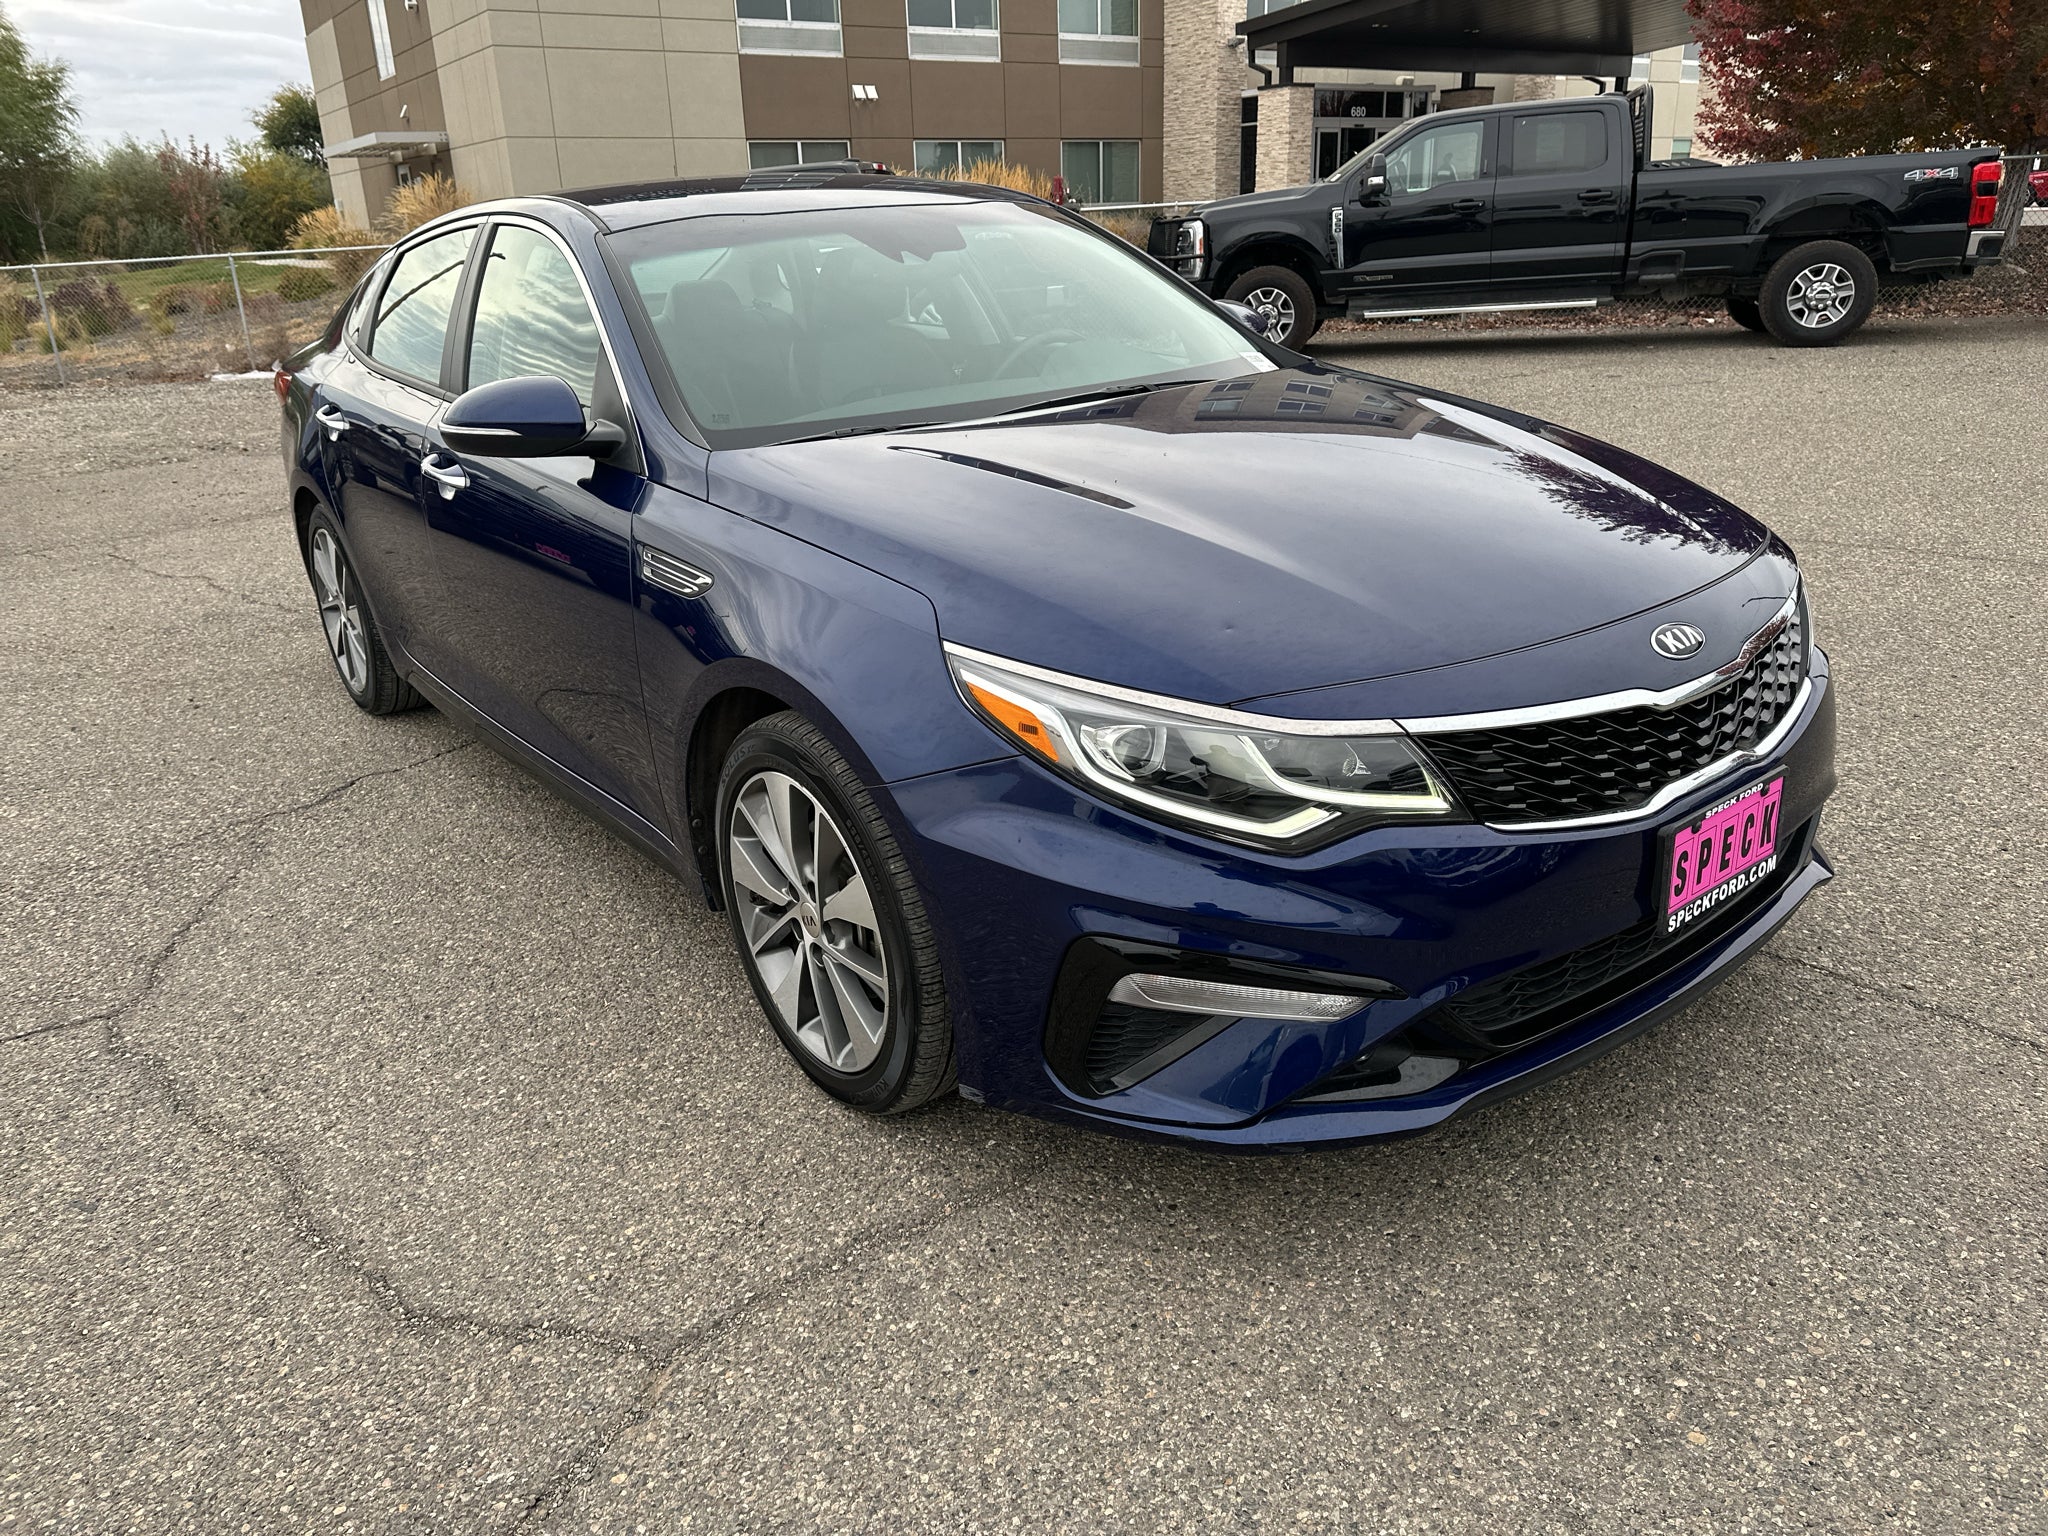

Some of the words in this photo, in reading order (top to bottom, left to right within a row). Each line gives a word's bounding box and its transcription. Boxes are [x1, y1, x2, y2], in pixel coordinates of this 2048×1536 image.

[1351, 106, 1366, 117] 680
[1657, 625, 1703, 653] KIA
[1705, 798, 1737, 819] SPECK
[1739, 782, 1764, 803] FORD
[1673, 800, 1777, 898] SPECK
[1667, 854, 1777, 933] SPECKFORD.COM
